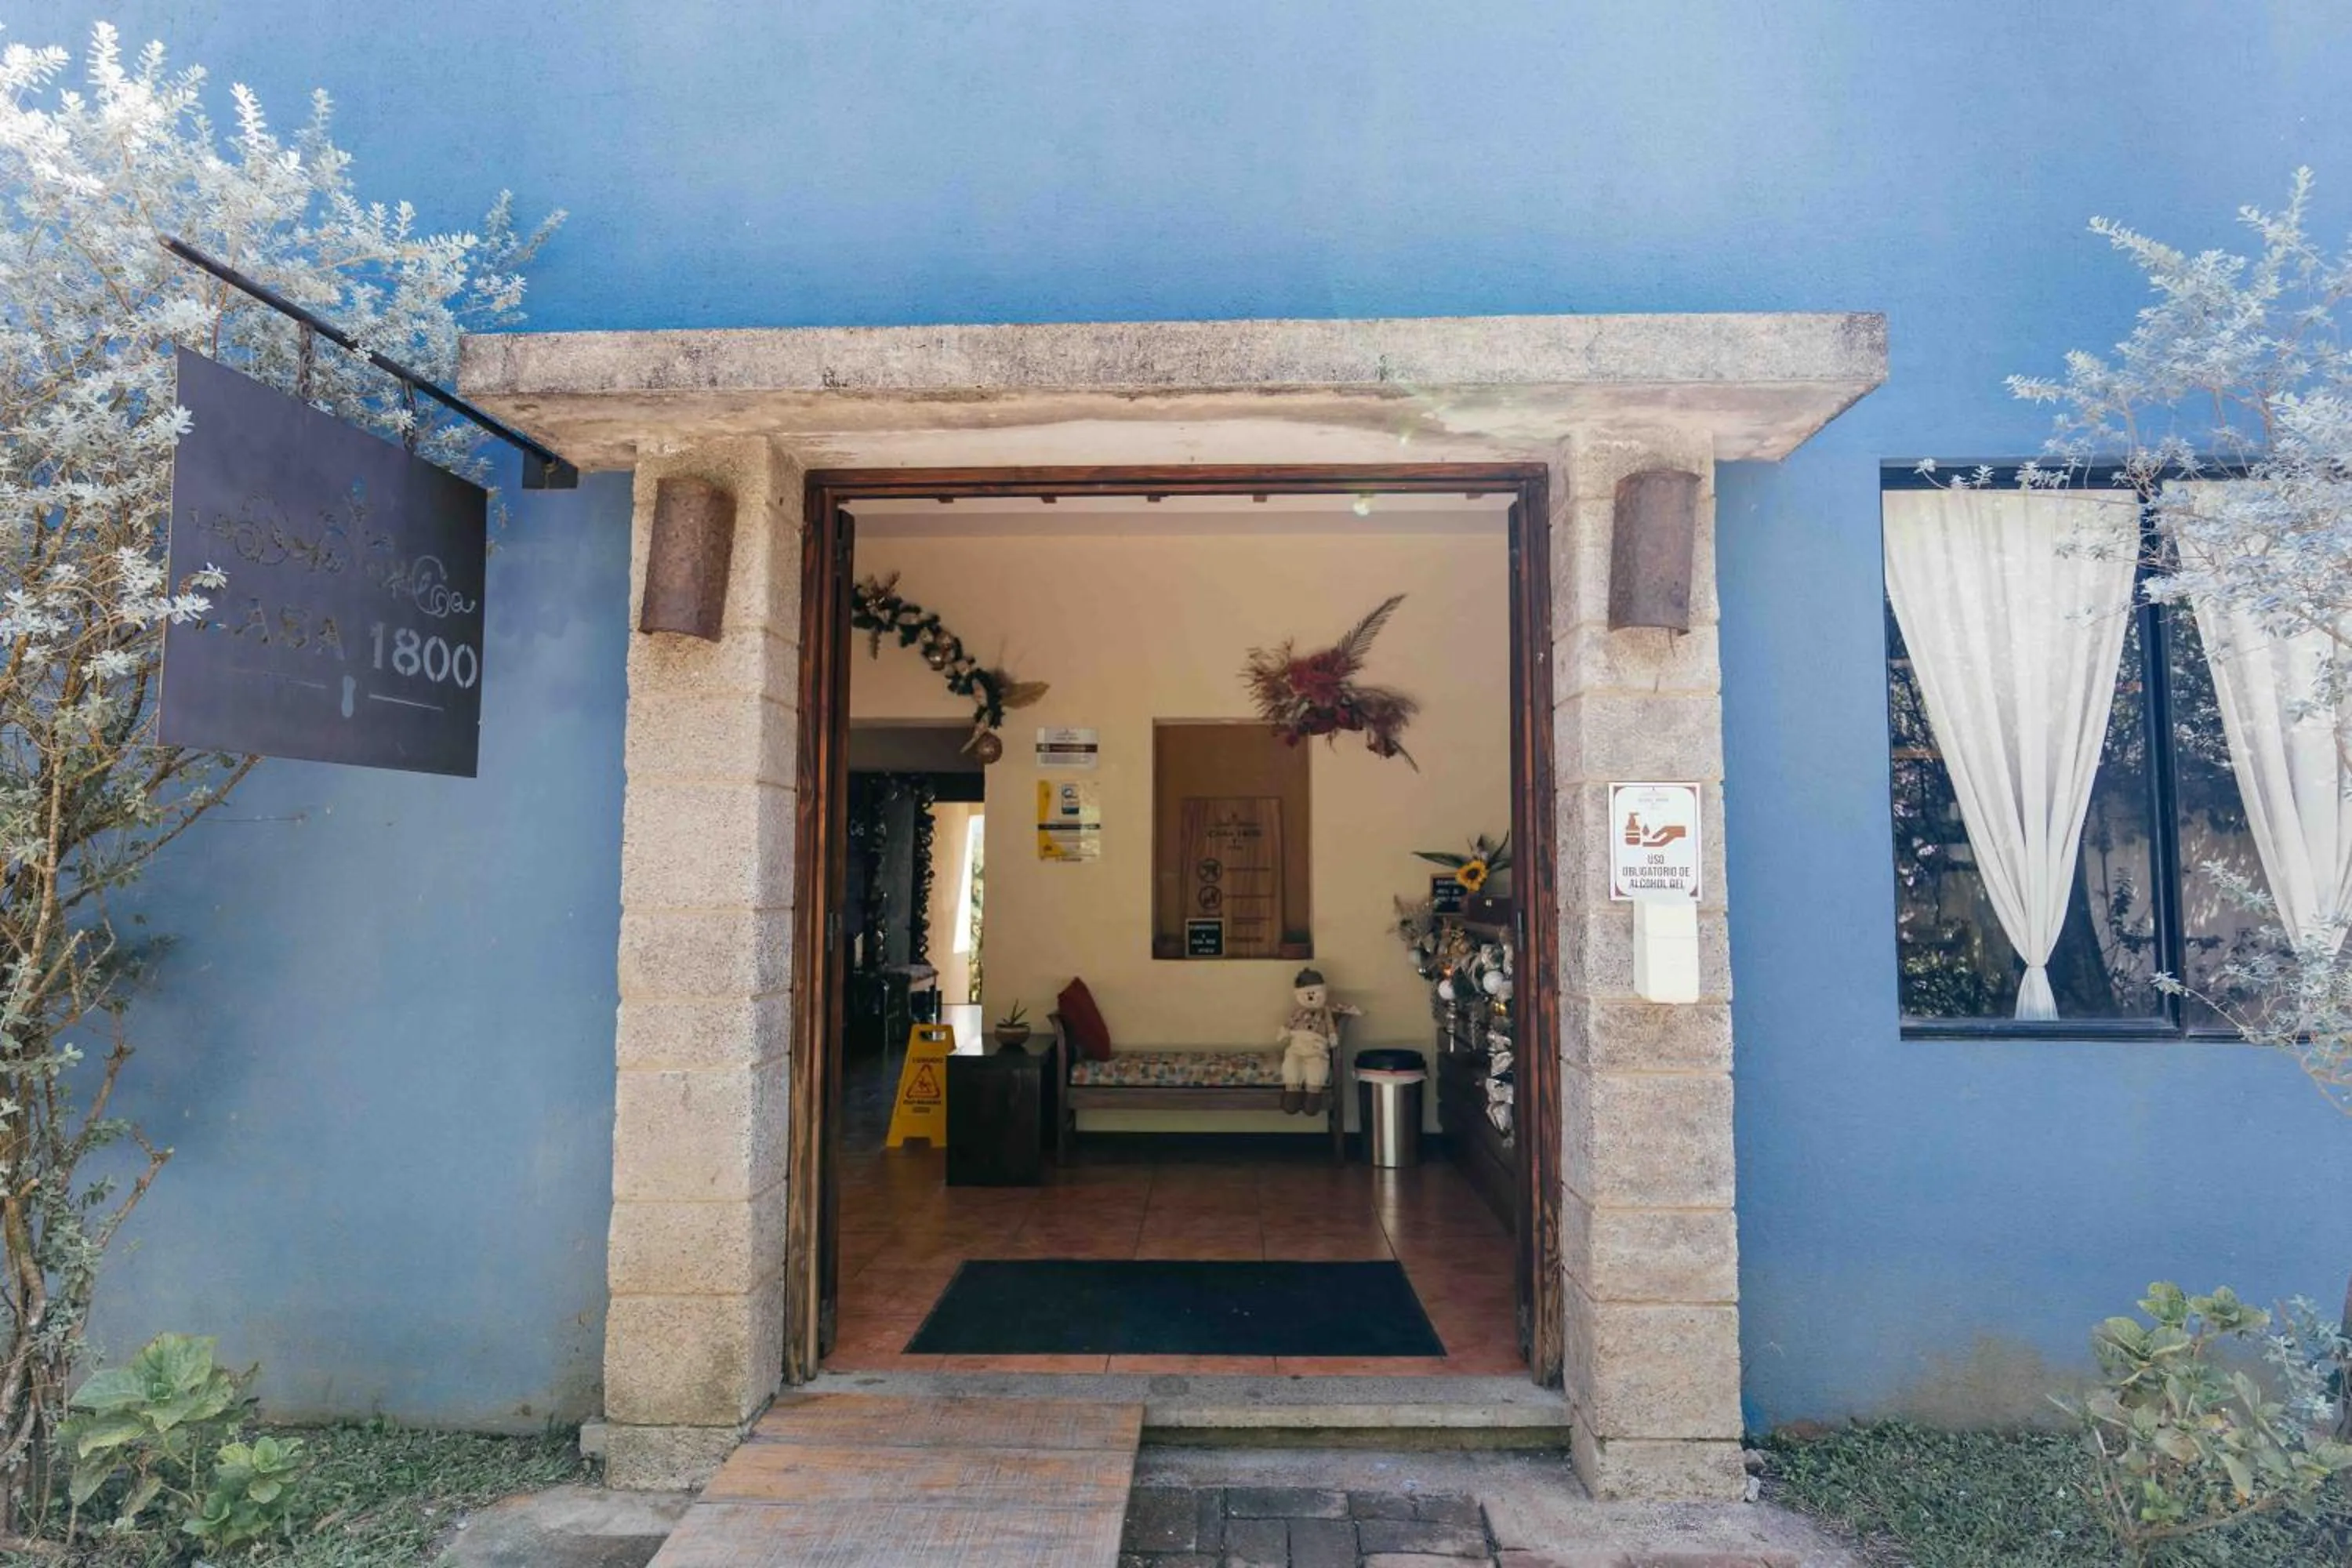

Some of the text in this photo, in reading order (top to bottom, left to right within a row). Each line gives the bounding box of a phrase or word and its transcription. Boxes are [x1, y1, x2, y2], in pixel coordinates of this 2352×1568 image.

[368, 622, 477, 689] 1800
[1647, 854, 1664, 865] USO
[1622, 866, 1690, 877] OBLIGATORIO DE
[1628, 878, 1685, 890] ALCOHOL GEL
